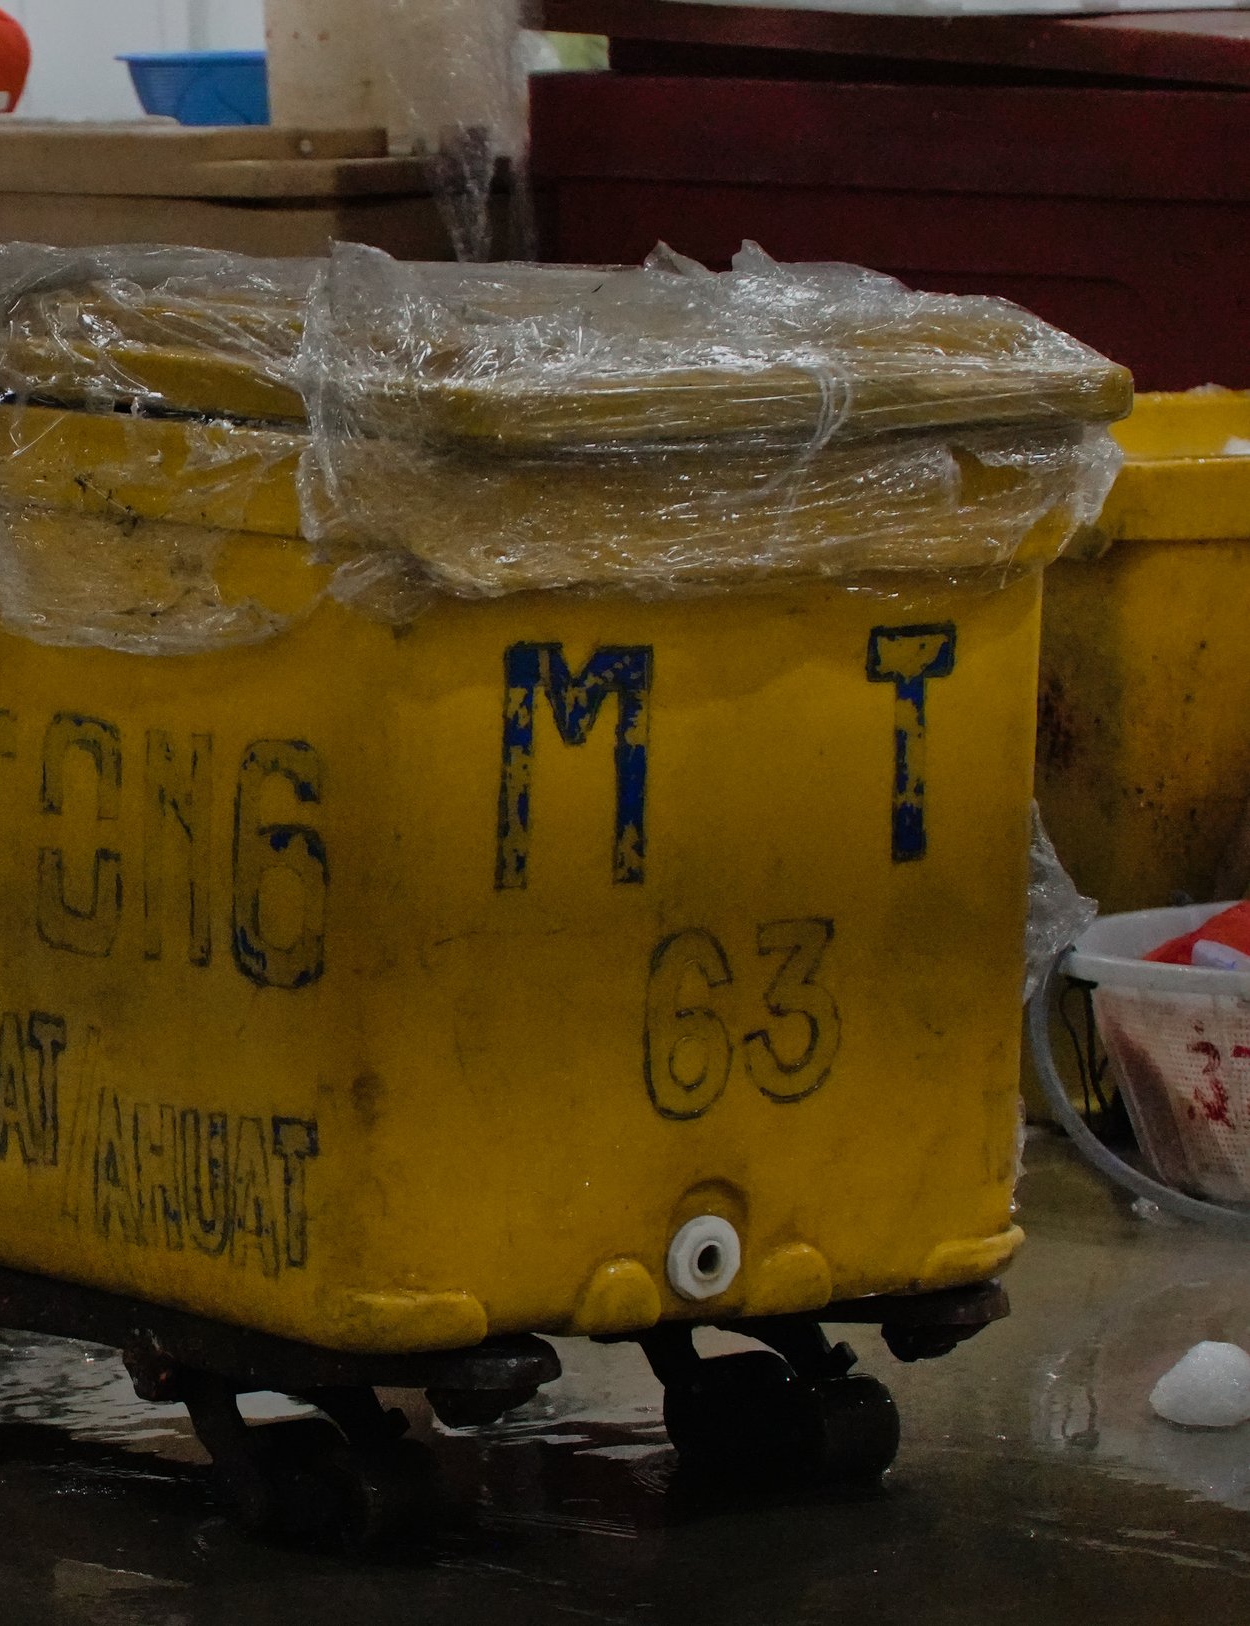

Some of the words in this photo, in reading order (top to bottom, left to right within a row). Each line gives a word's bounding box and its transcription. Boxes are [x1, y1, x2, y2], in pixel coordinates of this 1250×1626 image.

[493, 640, 654, 891] M
[865, 620, 957, 864] T
[642, 916, 842, 1120] 63
